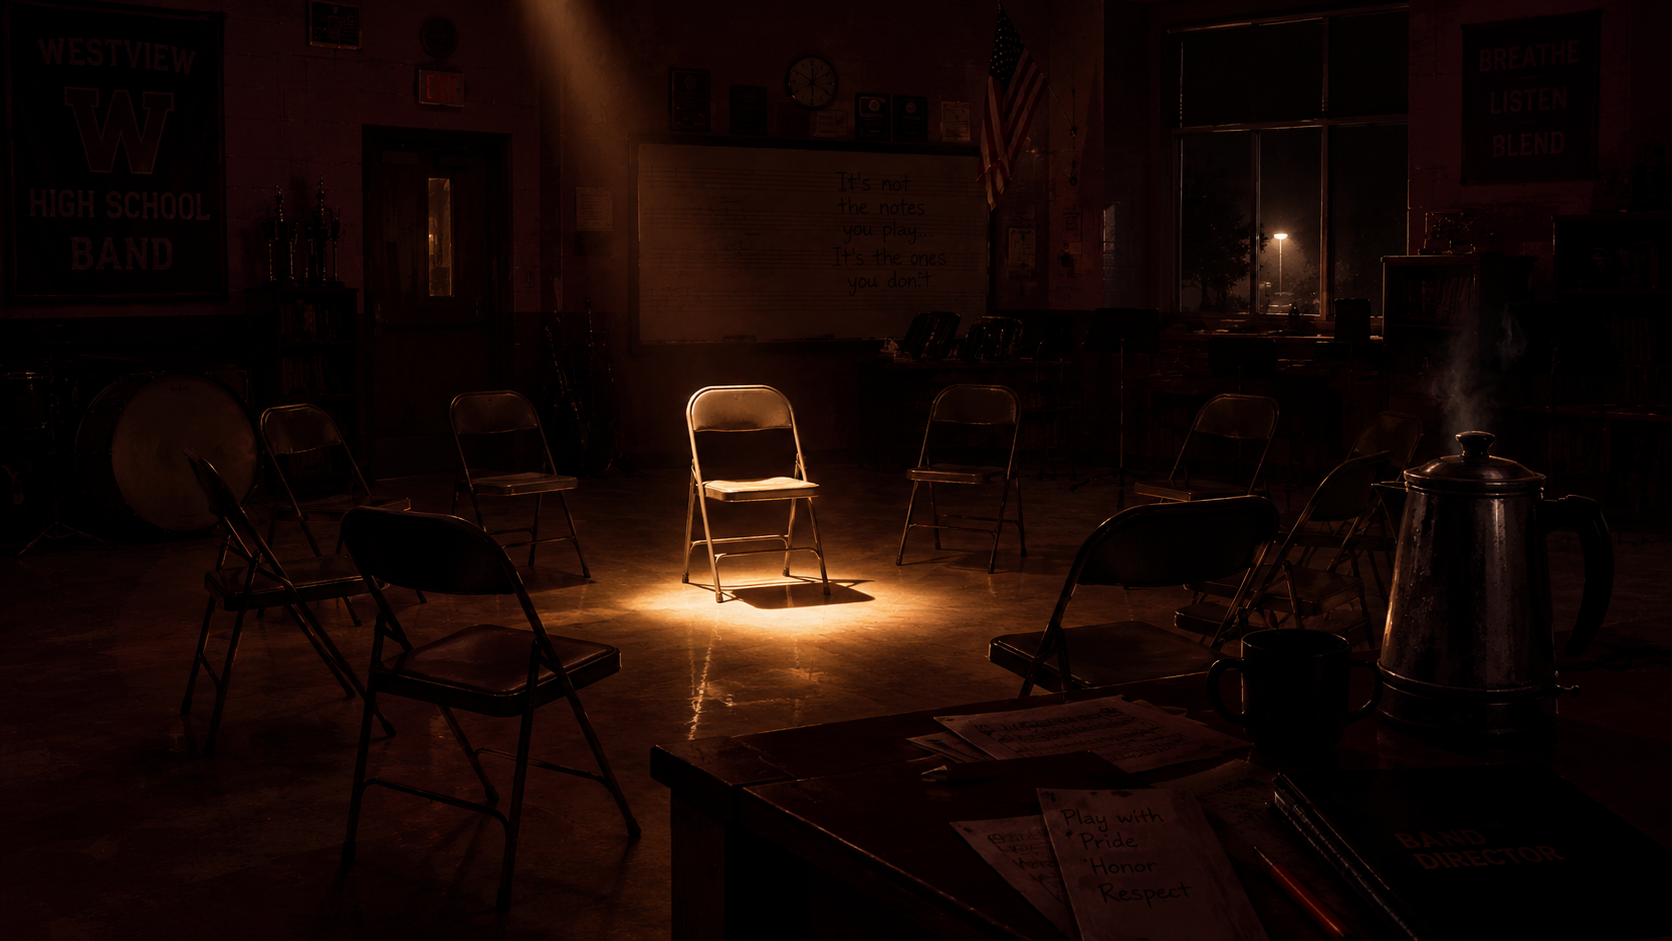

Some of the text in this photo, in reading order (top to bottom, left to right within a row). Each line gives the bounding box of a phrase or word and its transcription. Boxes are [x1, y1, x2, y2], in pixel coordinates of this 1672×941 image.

[37, 37, 196, 75] WESTVIEW
[1479, 39, 1580, 72] BREATHE
[1490, 86, 1568, 115] LISTEN
[64, 86, 174, 175] W
[1492, 131, 1565, 158] BLEND
[836, 171, 911, 192] It's not
[29, 188, 211, 221] HIGH SCHOOL
[837, 197, 925, 216] the notes
[843, 218, 933, 245] you play...
[70, 236, 173, 271] BAND
[832, 246, 947, 266] It's the ones
[847, 277, 878, 297] you
[1060, 807, 1164, 832] Play with
[1079, 832, 1138, 850] Pride
[1394, 829, 1487, 850] BAND
[1412, 845, 1566, 870] DIRECTOR
[1097, 882, 1191, 909] Respect
